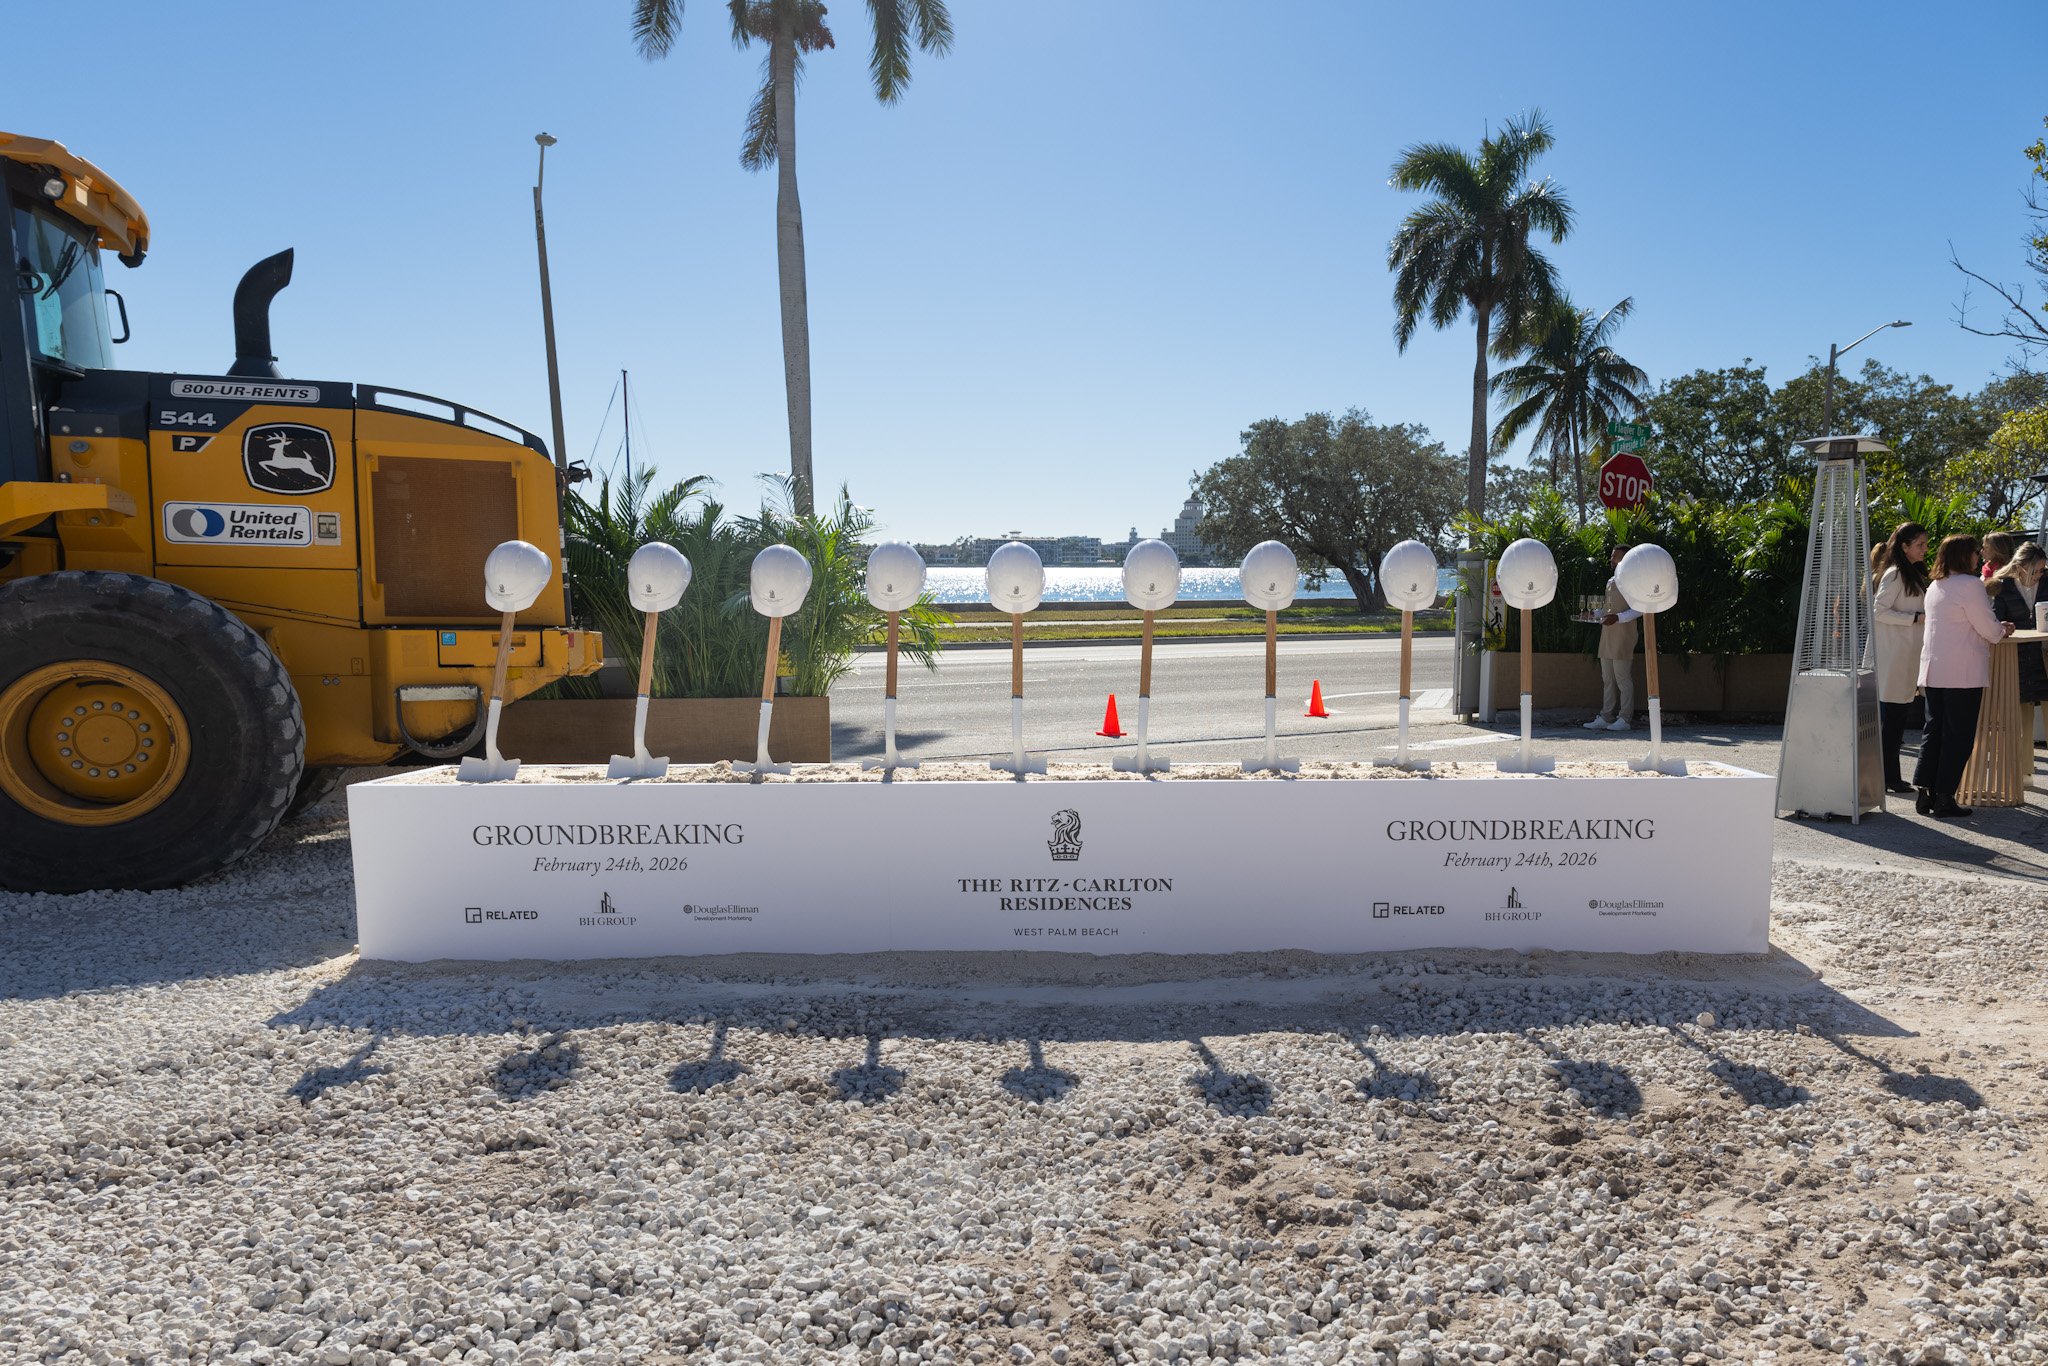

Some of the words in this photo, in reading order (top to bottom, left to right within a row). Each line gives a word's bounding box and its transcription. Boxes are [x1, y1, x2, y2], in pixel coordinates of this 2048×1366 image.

[181, 384, 310, 399] 800-UR-RENTS
[160, 410, 217, 427] 544
[179, 437, 197, 451] P
[1602, 471, 1650, 503] STOP
[229, 510, 297, 525] United
[229, 525, 304, 540] Rentals
[472, 823, 745, 847] GROUNDBREAKING
[1386, 818, 1656, 842] GROUNDBREAKING
[532, 856, 601, 877] February
[605, 856, 644, 874] 24th,
[648, 856, 688, 872] 2026
[1442, 851, 1512, 872] February
[1515, 851, 1553, 869] 24th,
[1557, 851, 1598, 867] 2026
[957, 878, 1003, 893] THE
[1000, 896, 1132, 912] RESIDENCES
[1393, 905, 1445, 915] RELATED
[485, 910, 539, 920] RELATED
[694, 914, 726, 922] Development
[727, 914, 753, 922] Marketing
[1485, 912, 1501, 921] BH
[1503, 912, 1542, 921] GROUP
[1598, 909, 1631, 917] Development
[1632, 909, 1657, 917] Marketing
[579, 916, 596, 927] BH
[598, 916, 637, 927] GROUP
[1013, 927, 1044, 937] WEST
[1048, 927, 1077, 937] PALM
[1081, 927, 1119, 937] BEACH
